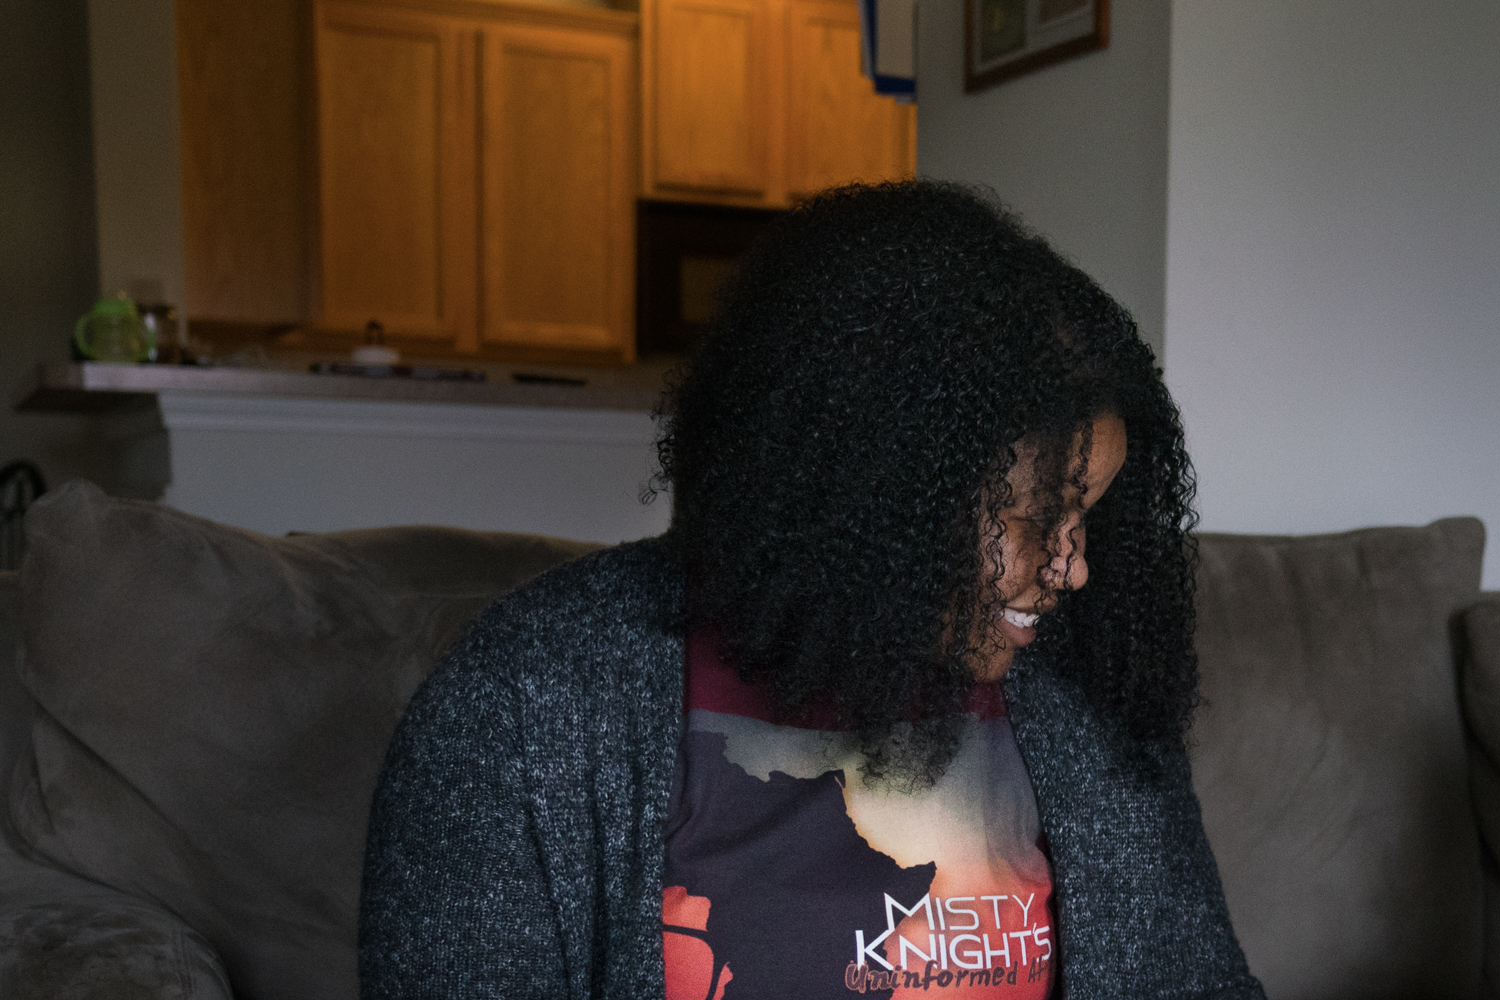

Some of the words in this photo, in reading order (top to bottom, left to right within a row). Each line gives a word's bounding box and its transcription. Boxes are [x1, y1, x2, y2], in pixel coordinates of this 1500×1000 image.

[884, 892, 1035, 931] MISTY
[855, 923, 1052, 971] KNIGHT'S
[845, 960, 1018, 993] Uninformed
